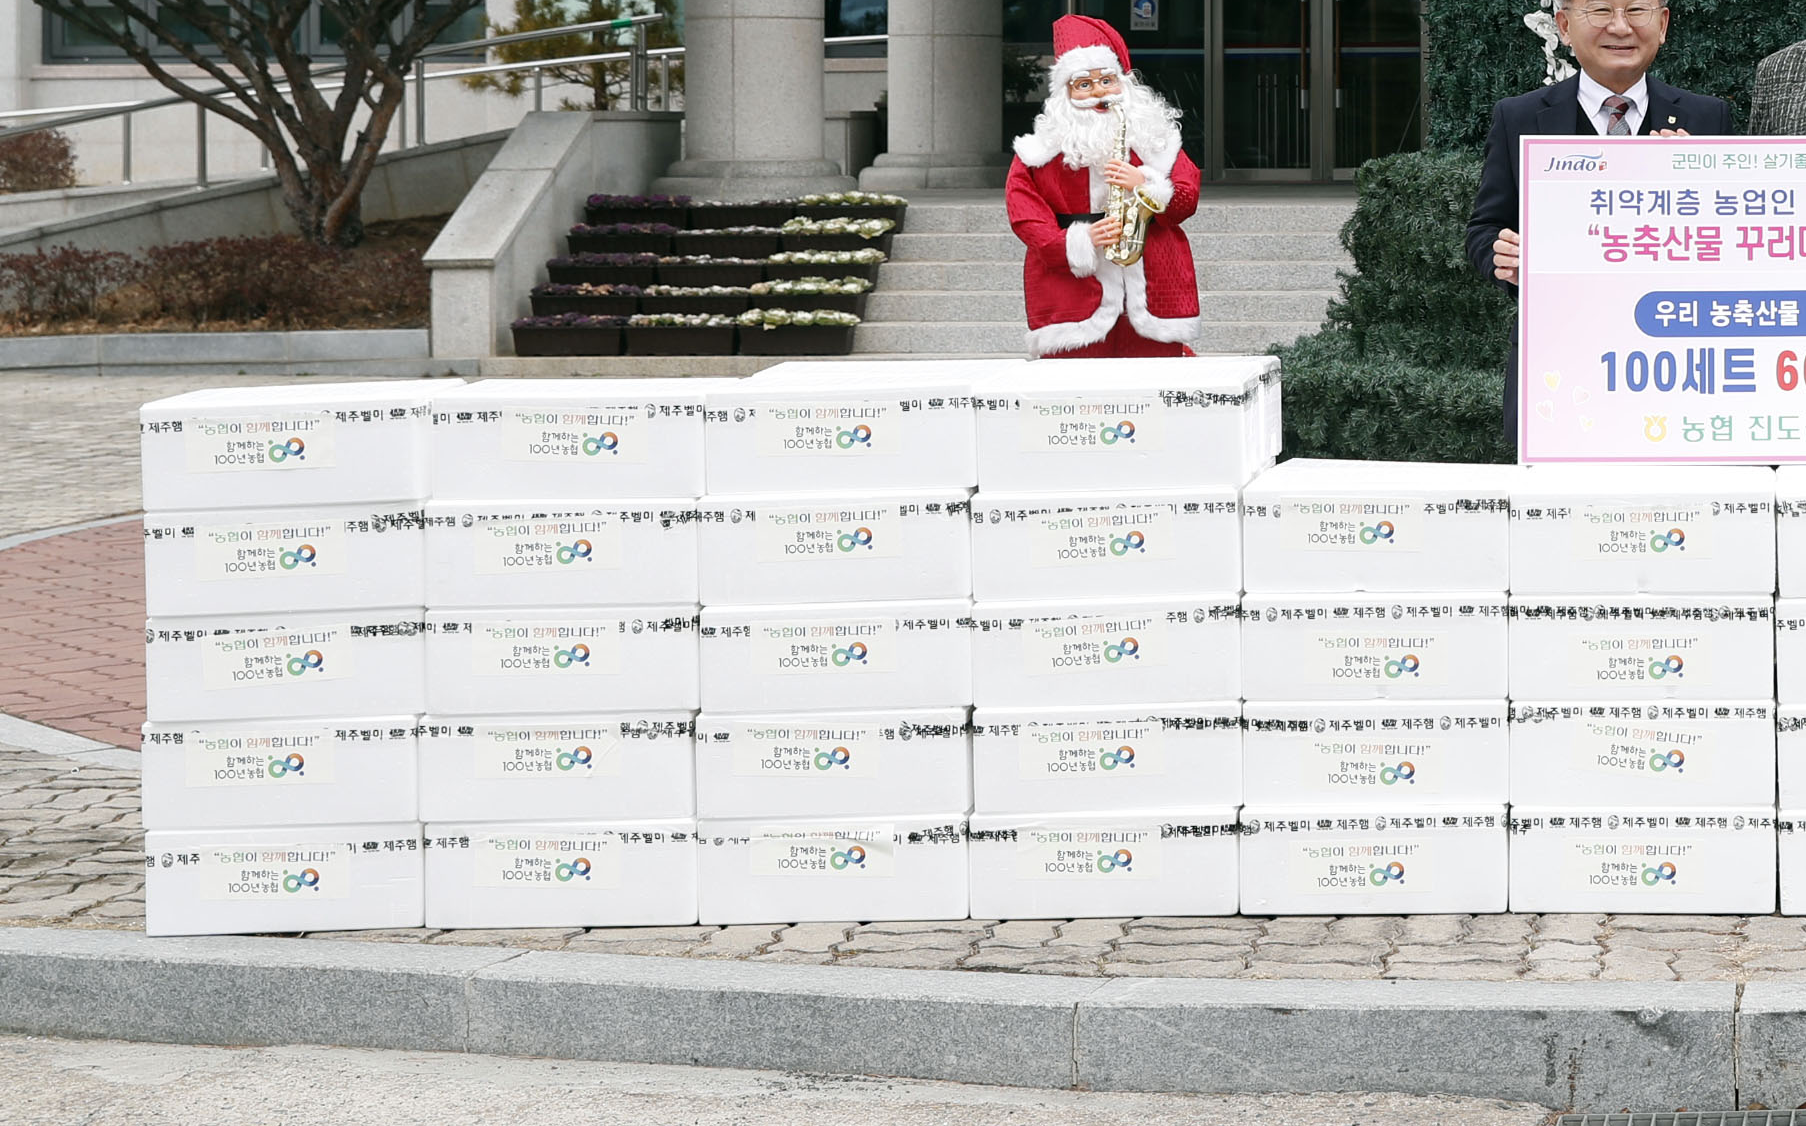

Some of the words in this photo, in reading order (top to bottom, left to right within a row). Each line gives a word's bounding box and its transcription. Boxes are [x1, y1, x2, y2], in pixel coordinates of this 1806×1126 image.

[1543, 156, 1598, 172] Jindo
[1671, 153, 1717, 170] 군민이
[1721, 153, 1758, 170] 주인!
[1590, 188, 1701, 217] 취약계층
[1713, 188, 1795, 217] 농업인
[1654, 300, 1698, 327] 우리
[1709, 299, 1800, 327] 농축산물
[1600, 347, 1757, 395] 100세트
[795, 426, 832, 438] 함께하는
[1059, 422, 1096, 434] 함께하는
[1681, 415, 1735, 443] 농협
[541, 431, 579, 443] 함께하는
[225, 440, 264, 453] 함께하는
[1319, 521, 1356, 532] 함께하는
[795, 530, 833, 543] 함께하는
[1068, 534, 1106, 548] 함께하는
[1609, 530, 1646, 542] 함께하는
[236, 547, 275, 561] 함께하는
[514, 542, 552, 555] 함께하는
[512, 645, 550, 657] 함께하는
[790, 644, 828, 656] 함께하는
[1062, 642, 1100, 655] 함께하는
[243, 655, 282, 669] 함께하는
[1343, 655, 1381, 667] 함께하는
[1607, 656, 1645, 669] 함께하는
[773, 746, 811, 758] 함께하는
[1058, 748, 1096, 761] 함께하는
[225, 755, 264, 768] 함께하는
[1339, 761, 1376, 773] 함께하는
[1056, 849, 1093, 861] 함께하는
[514, 857, 552, 869] 함께하는
[1328, 863, 1366, 876] 함께하는
[1600, 862, 1638, 874] 함께하는
[240, 869, 279, 882] 함께하는
